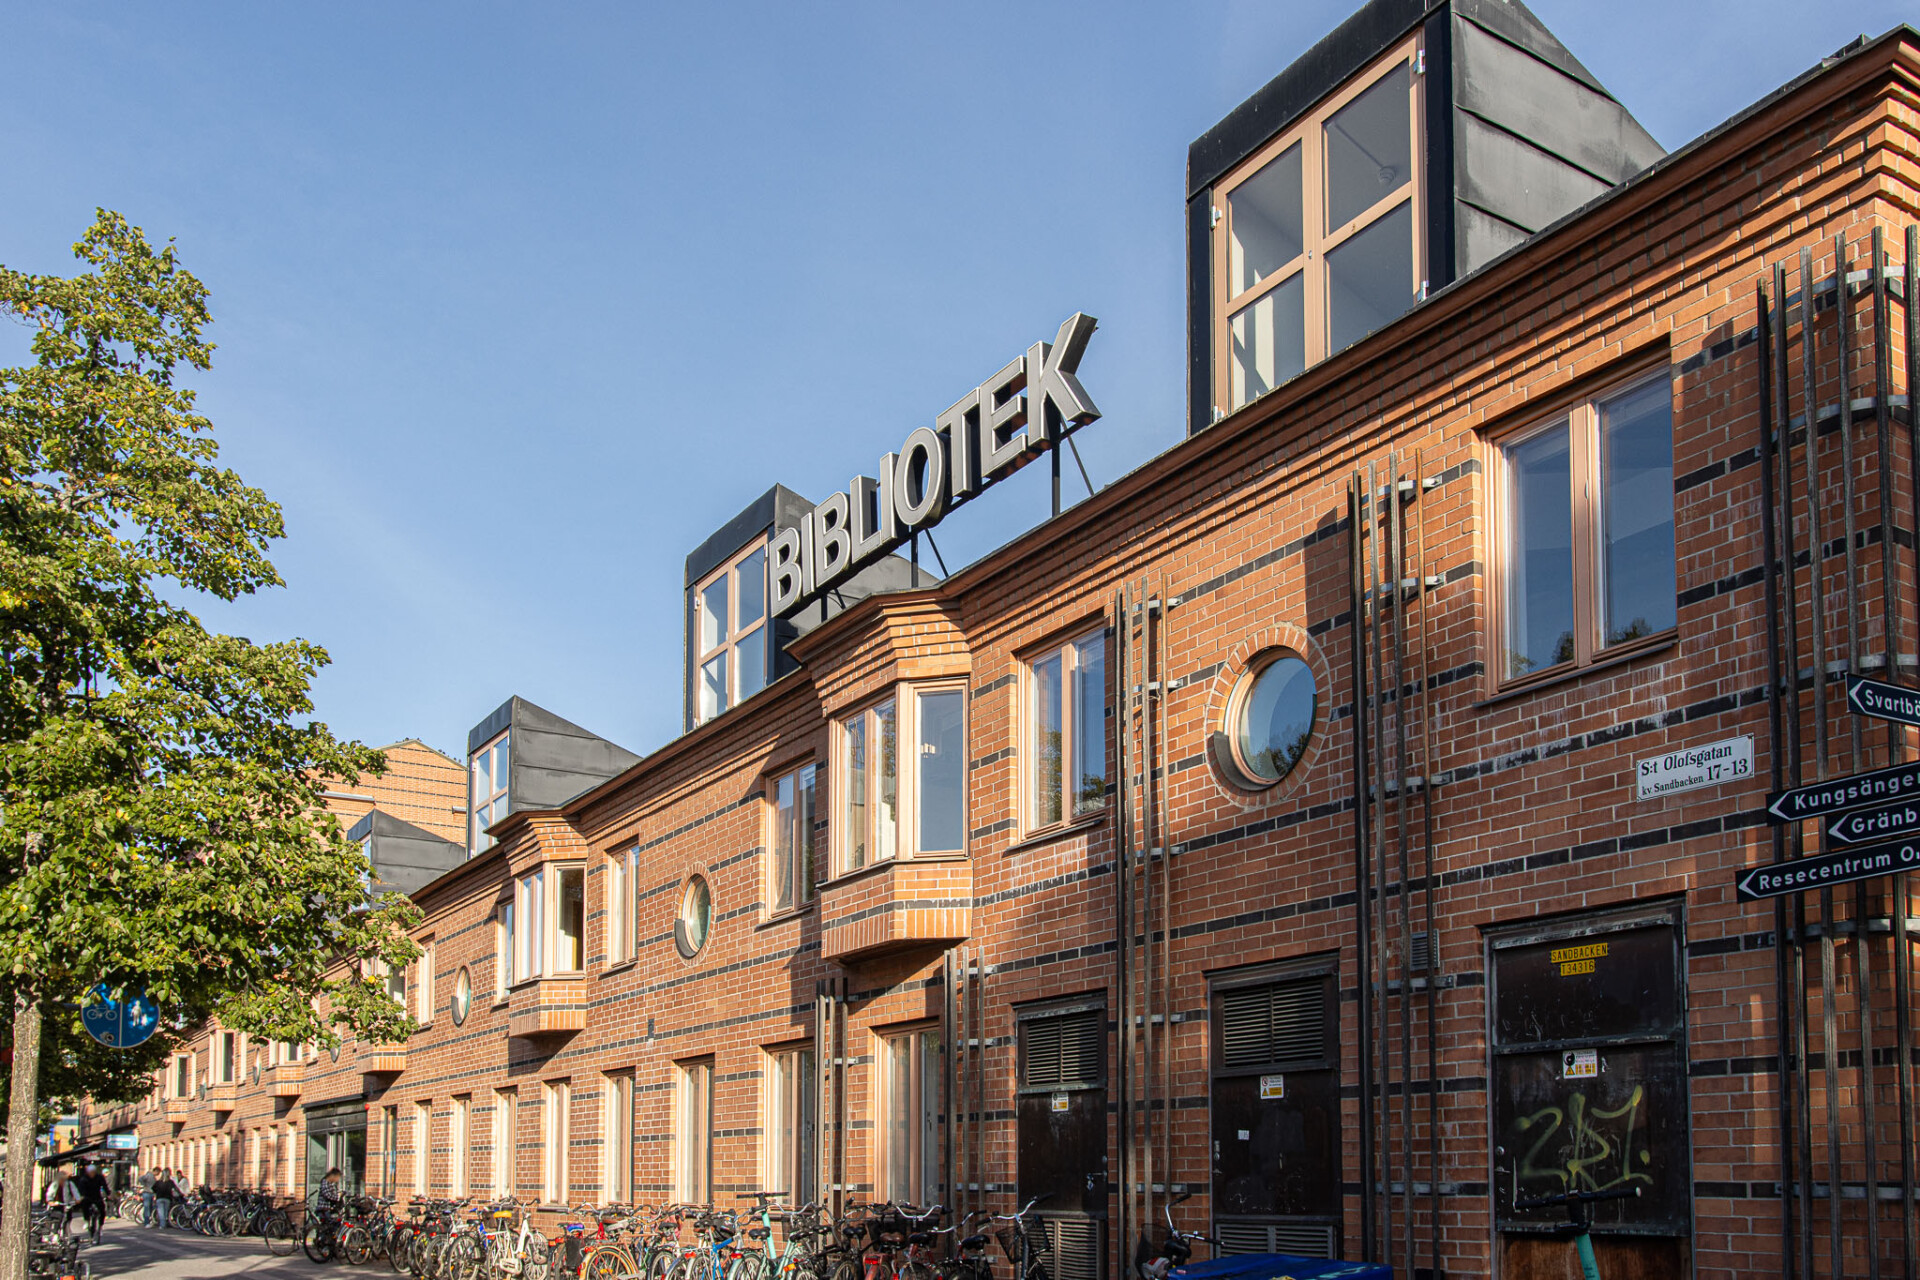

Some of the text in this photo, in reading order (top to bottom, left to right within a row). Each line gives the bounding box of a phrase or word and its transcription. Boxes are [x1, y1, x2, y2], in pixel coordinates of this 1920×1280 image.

[769, 311, 1102, 619] BIBLIOTEK
[1641, 746, 1732, 776] S:t Olofsgatan
[1642, 758, 1748, 796] kv Sandbacken 17-13
[1795, 772, 1920, 810] Kungsänge
[1760, 854, 1891, 890] Resecentrum
[1552, 944, 1607, 961] SANDBACKEN
[1562, 961, 1594, 975] T34316
